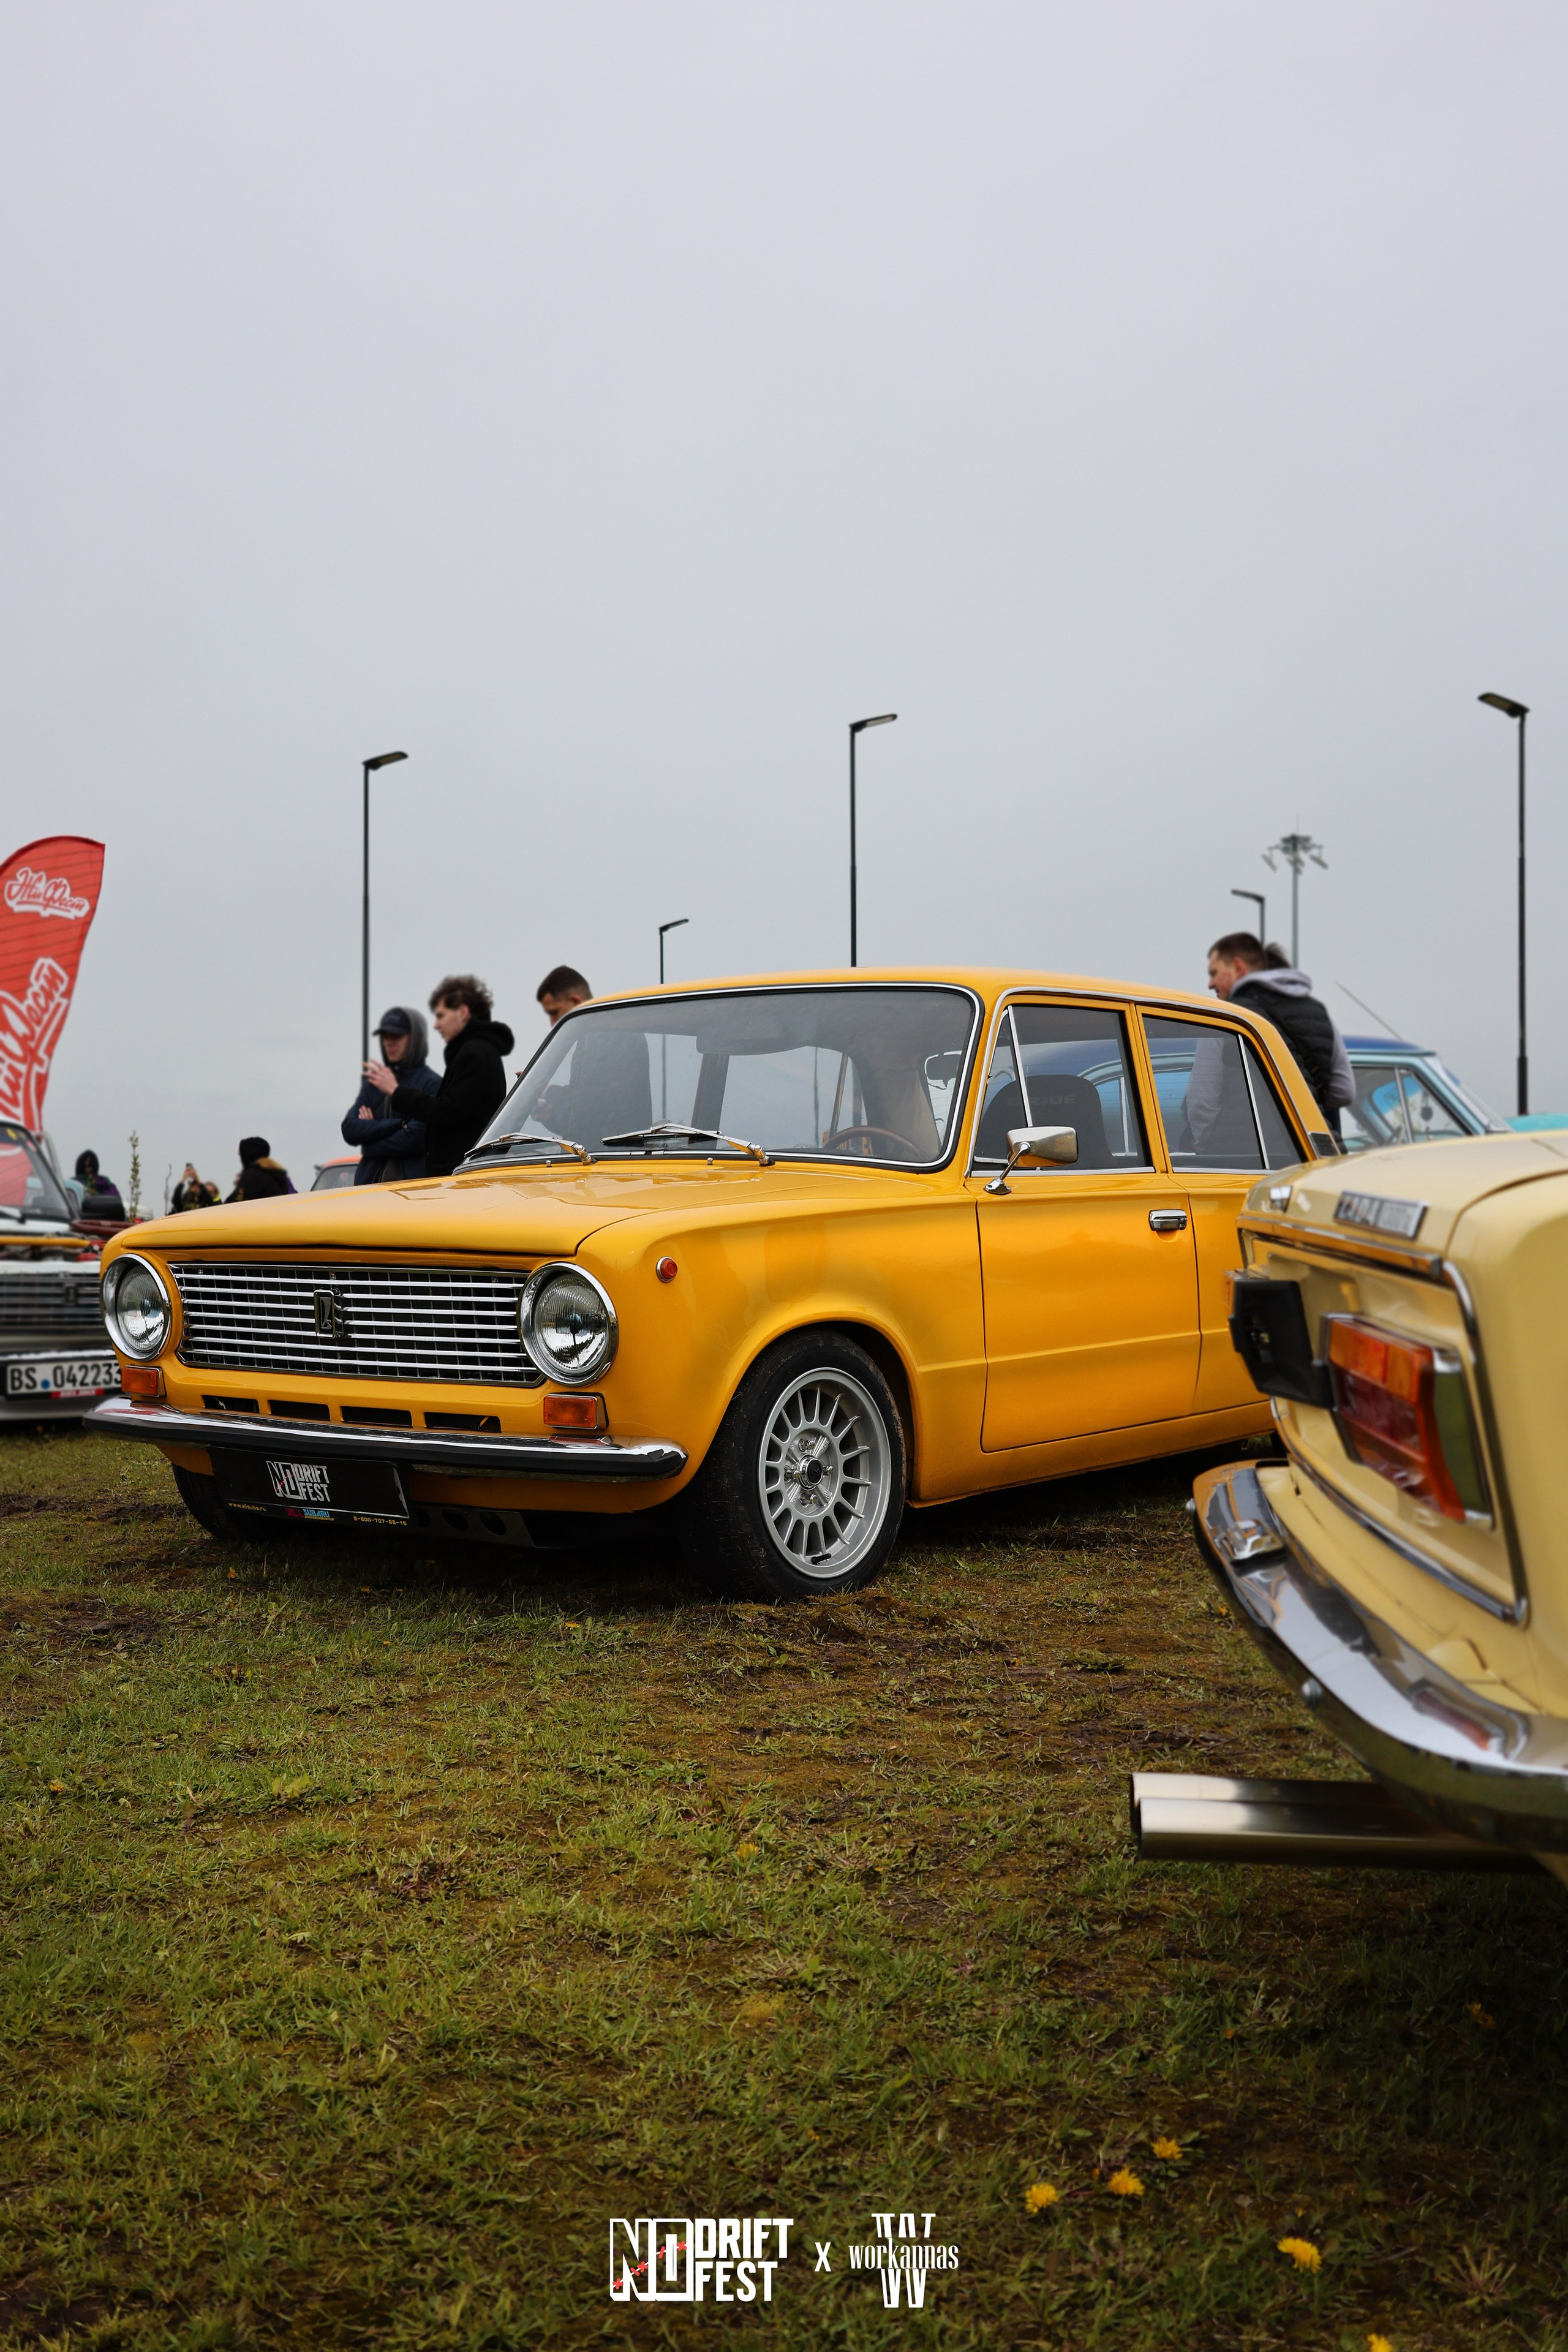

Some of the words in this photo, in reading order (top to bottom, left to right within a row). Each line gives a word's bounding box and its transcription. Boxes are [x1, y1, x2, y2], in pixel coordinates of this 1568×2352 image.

[10, 1366, 37, 1391] BS
[293, 1463, 330, 1483] DRIFT
[299, 1482, 331, 1502] FEST
[303, 1509, 330, 1518] SUBARU
